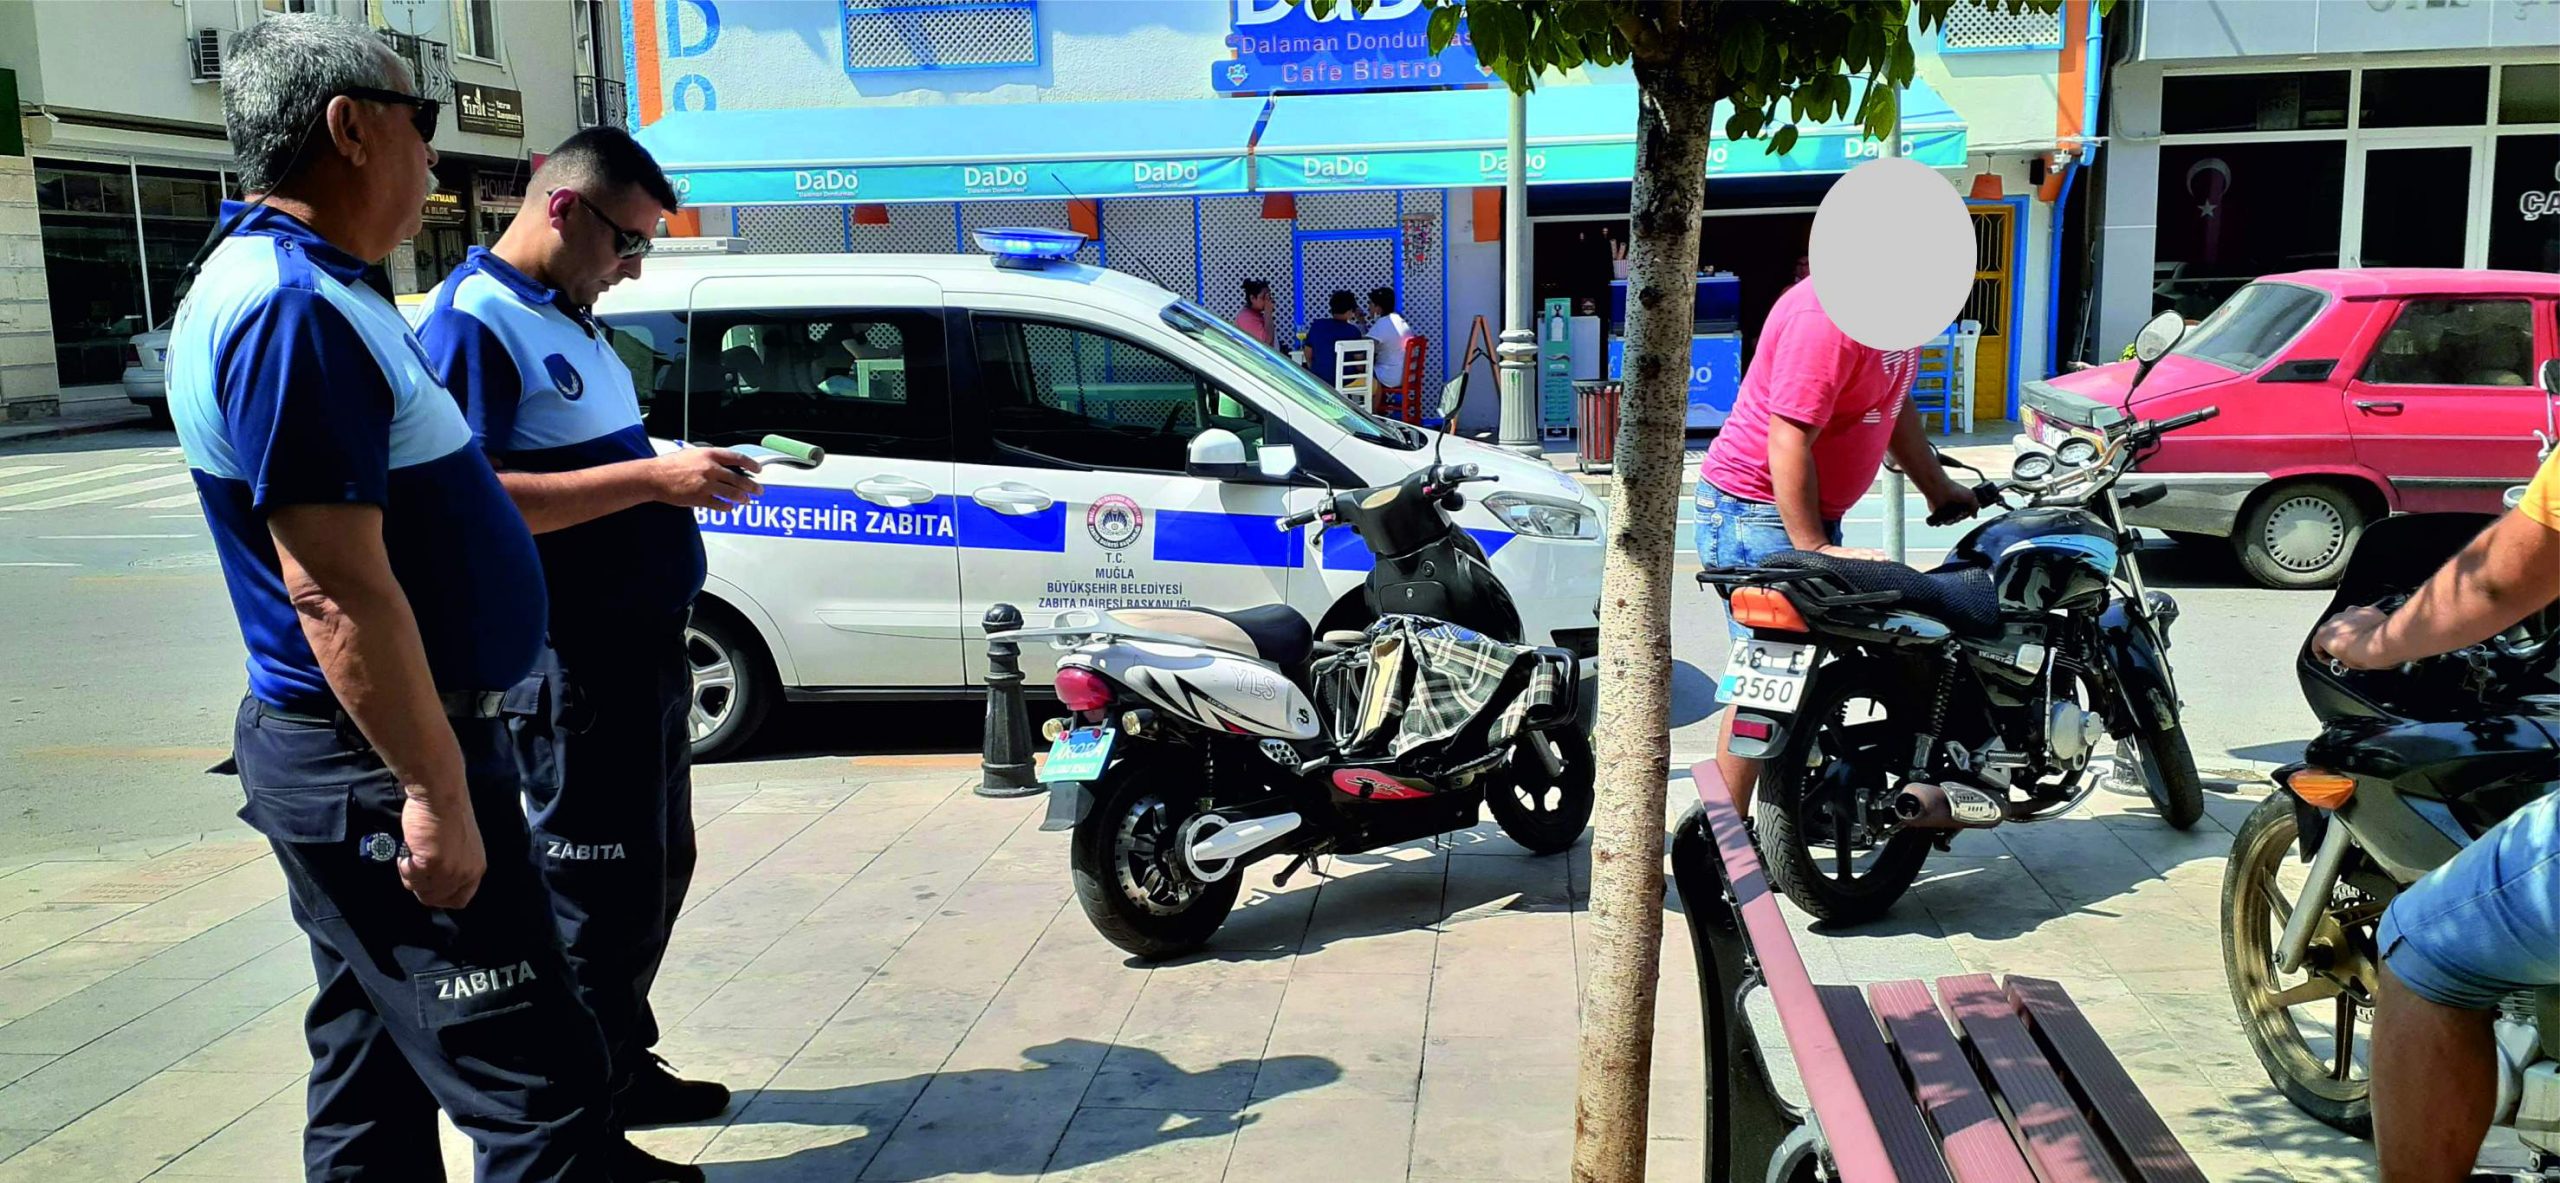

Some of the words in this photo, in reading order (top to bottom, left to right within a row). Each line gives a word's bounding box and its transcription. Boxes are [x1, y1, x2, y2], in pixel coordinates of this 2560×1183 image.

[1242, 35, 1339, 54] Dalaman
[1281, 63, 1343, 83] Cafe
[1353, 60, 1442, 80] Bistro
[964, 166, 1028, 187] DaDo
[1134, 161, 1198, 182] DaDo
[1303, 156, 1368, 177] DaDo
[795, 168, 859, 191] DaDo
[865, 511, 954, 537] ZABITA
[1105, 552, 1126, 564] T.C.
[1095, 566, 1135, 579] MUĞLA
[1047, 580, 1117, 596] BÜYÜKŞEHİR
[1120, 581, 1183, 595] BELEDİYESİ
[1038, 597, 1077, 608] ZABITA
[1731, 675, 1794, 703] 3560
[546, 841, 626, 860] ZABITA
[434, 960, 537, 1000] ZABITA
